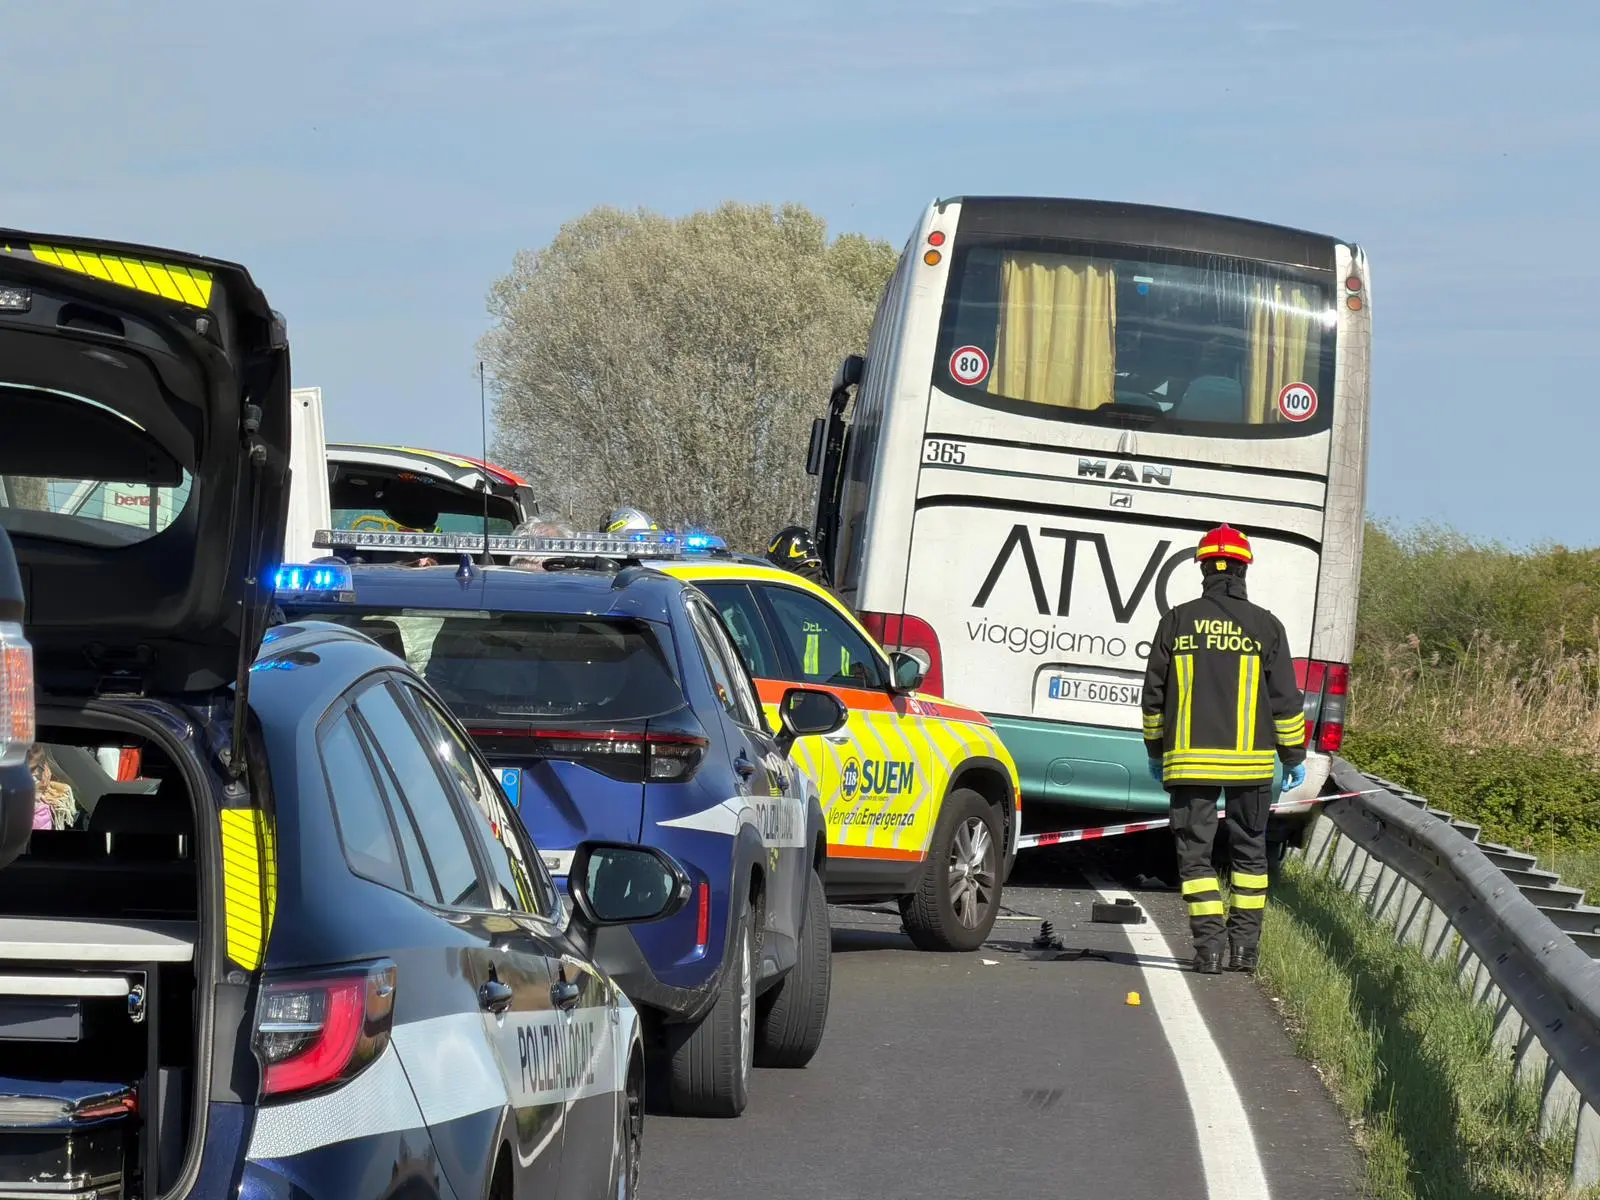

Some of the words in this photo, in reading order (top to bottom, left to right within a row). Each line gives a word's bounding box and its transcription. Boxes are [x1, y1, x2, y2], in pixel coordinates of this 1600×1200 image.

[959, 356, 979, 373] 80
[1286, 392, 1309, 411] 100
[926, 440, 966, 465] 365
[1077, 457, 1173, 486] MAN
[966, 617, 1126, 657] viaggiamo
[1061, 680, 1082, 698] DY
[1088, 683, 1140, 705] 606SW
[845, 771, 857, 786] 118
[860, 759, 915, 795] SUEM
[517, 1023, 563, 1094] POLIZIA
